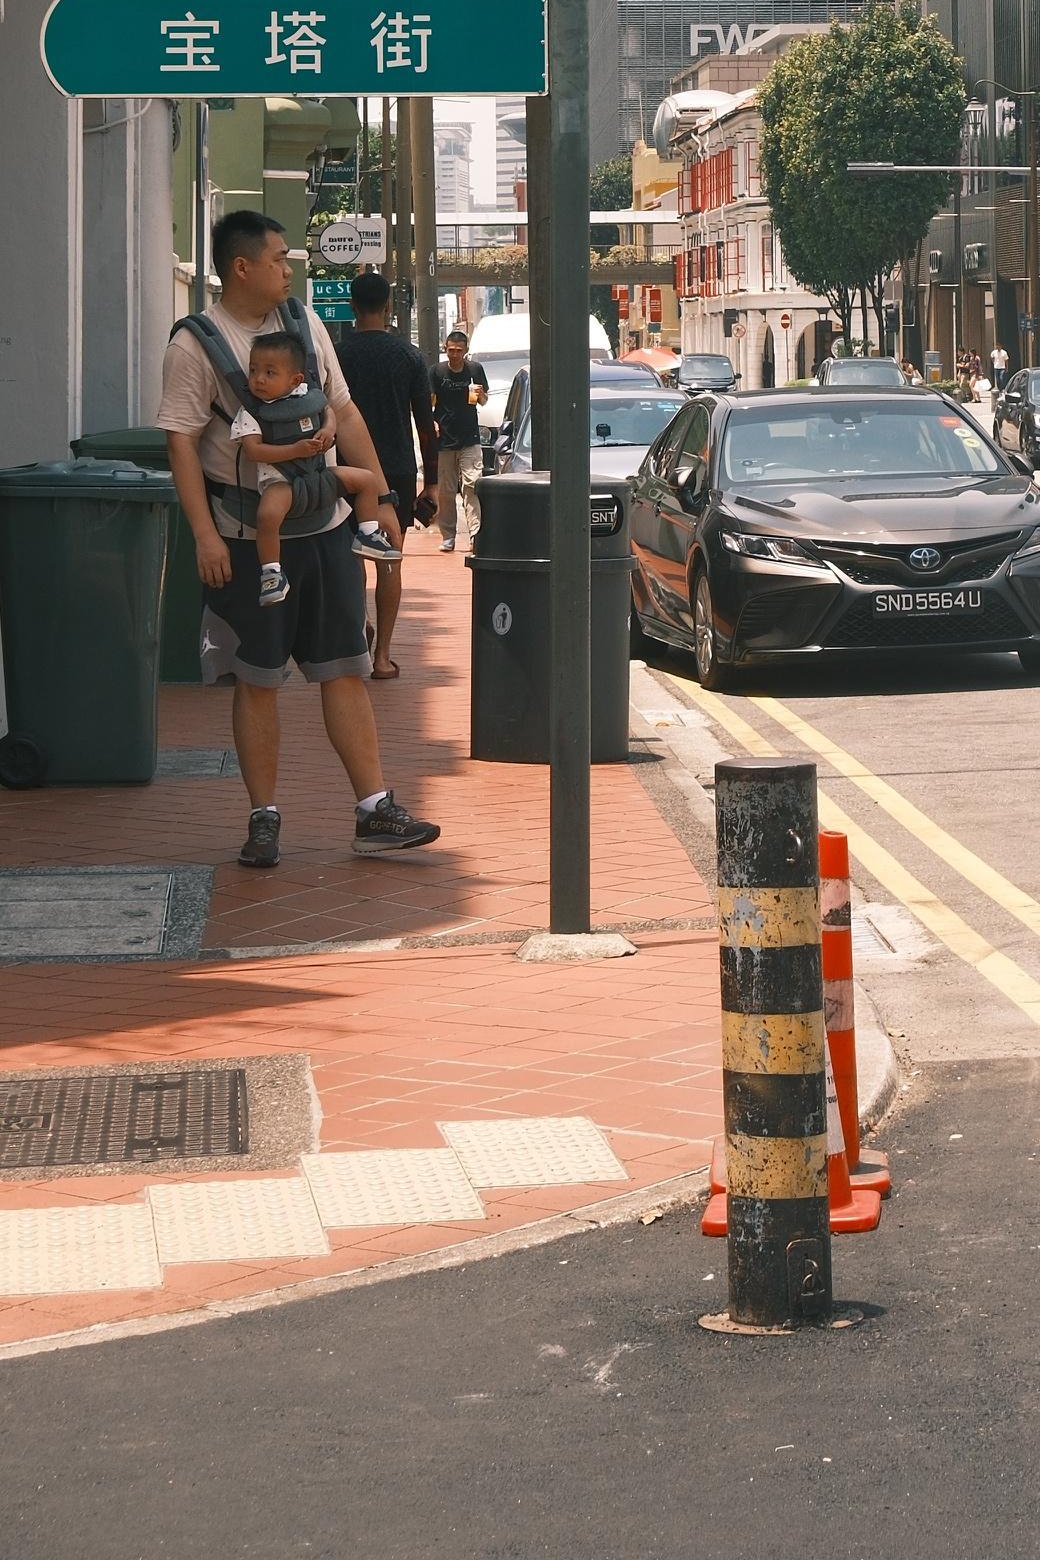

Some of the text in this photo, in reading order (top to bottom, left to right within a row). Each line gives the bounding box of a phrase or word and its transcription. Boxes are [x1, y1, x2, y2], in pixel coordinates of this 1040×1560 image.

[159, 10, 433, 75] 宝塔街
[321, 244, 360, 252] COFFEE
[337, 282, 351, 294] St
[875, 590, 981, 612] SND5564U
